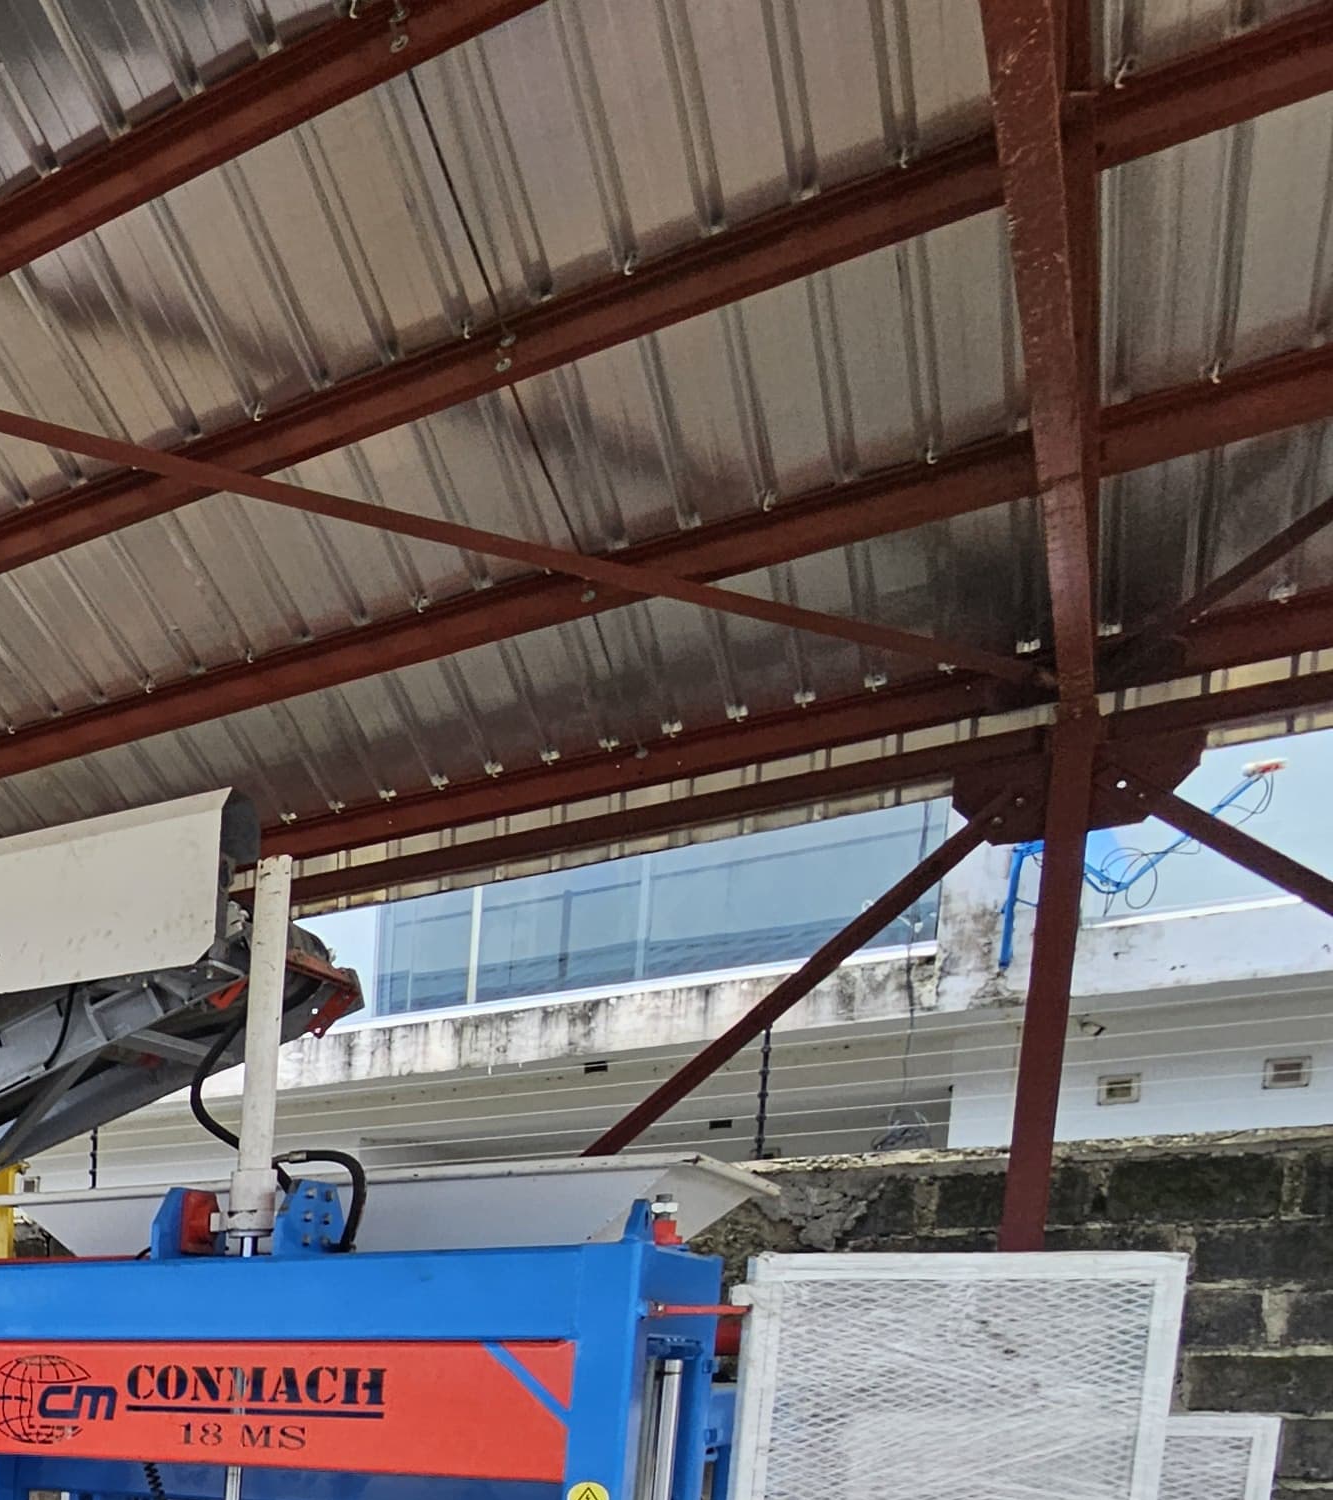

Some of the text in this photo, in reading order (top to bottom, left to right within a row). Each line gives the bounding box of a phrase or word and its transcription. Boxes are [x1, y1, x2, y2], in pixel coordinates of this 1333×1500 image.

[126, 1364, 387, 1406] CONMACH
[179, 1421, 307, 1451] 18 MS
